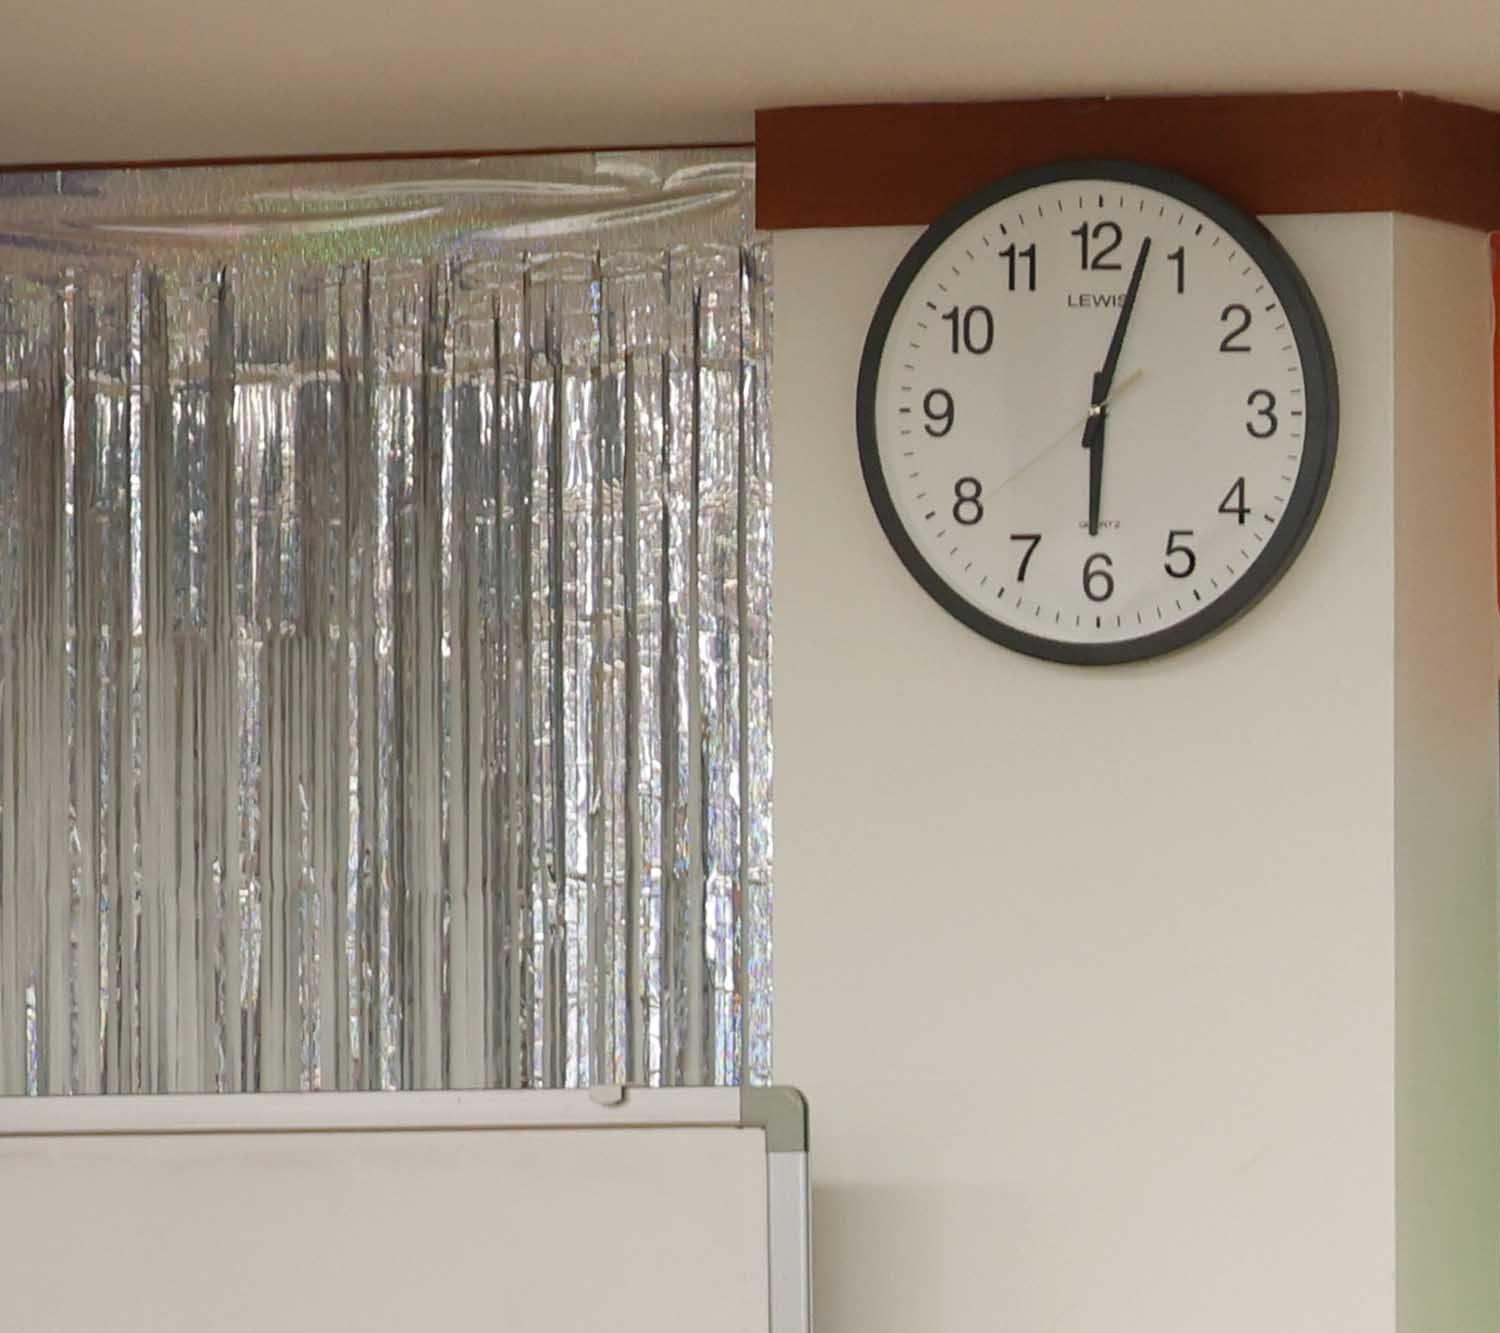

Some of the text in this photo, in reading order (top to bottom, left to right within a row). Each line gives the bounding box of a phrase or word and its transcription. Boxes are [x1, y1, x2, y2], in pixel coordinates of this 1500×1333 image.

[999, 243, 1037, 292] 11
[1072, 221, 1123, 271] 12
[1167, 245, 1185, 295] 1
[942, 304, 995, 355] 10
[1219, 303, 1252, 353] 2
[922, 388, 955, 438] 9
[1245, 389, 1279, 439] 3
[952, 476, 984, 526] 8
[1217, 476, 1252, 526] 4
[1009, 533, 1043, 583] 7
[1082, 552, 1115, 602] 6
[1164, 529, 1197, 579] 5
